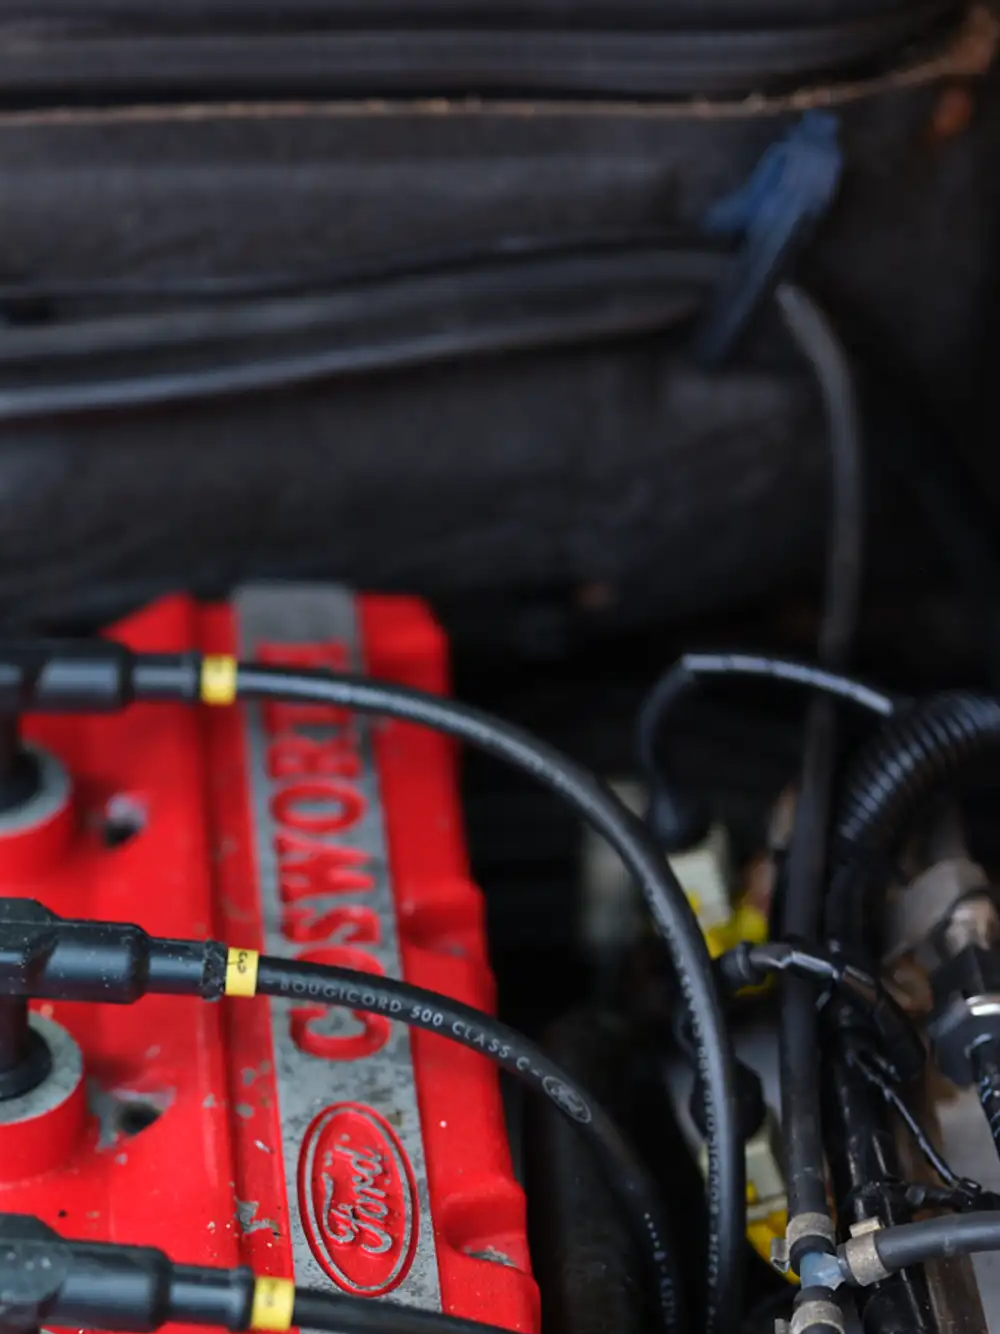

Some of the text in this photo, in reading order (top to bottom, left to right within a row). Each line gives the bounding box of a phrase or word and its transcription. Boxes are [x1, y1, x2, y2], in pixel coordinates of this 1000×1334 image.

[280, 974, 402, 1013] BOUGICORD
[410, 1005, 443, 1027] 500
[452, 1020, 511, 1058] CLASS
[516, 1056, 530, 1071] C
[321, 1133, 392, 1254] Ford
